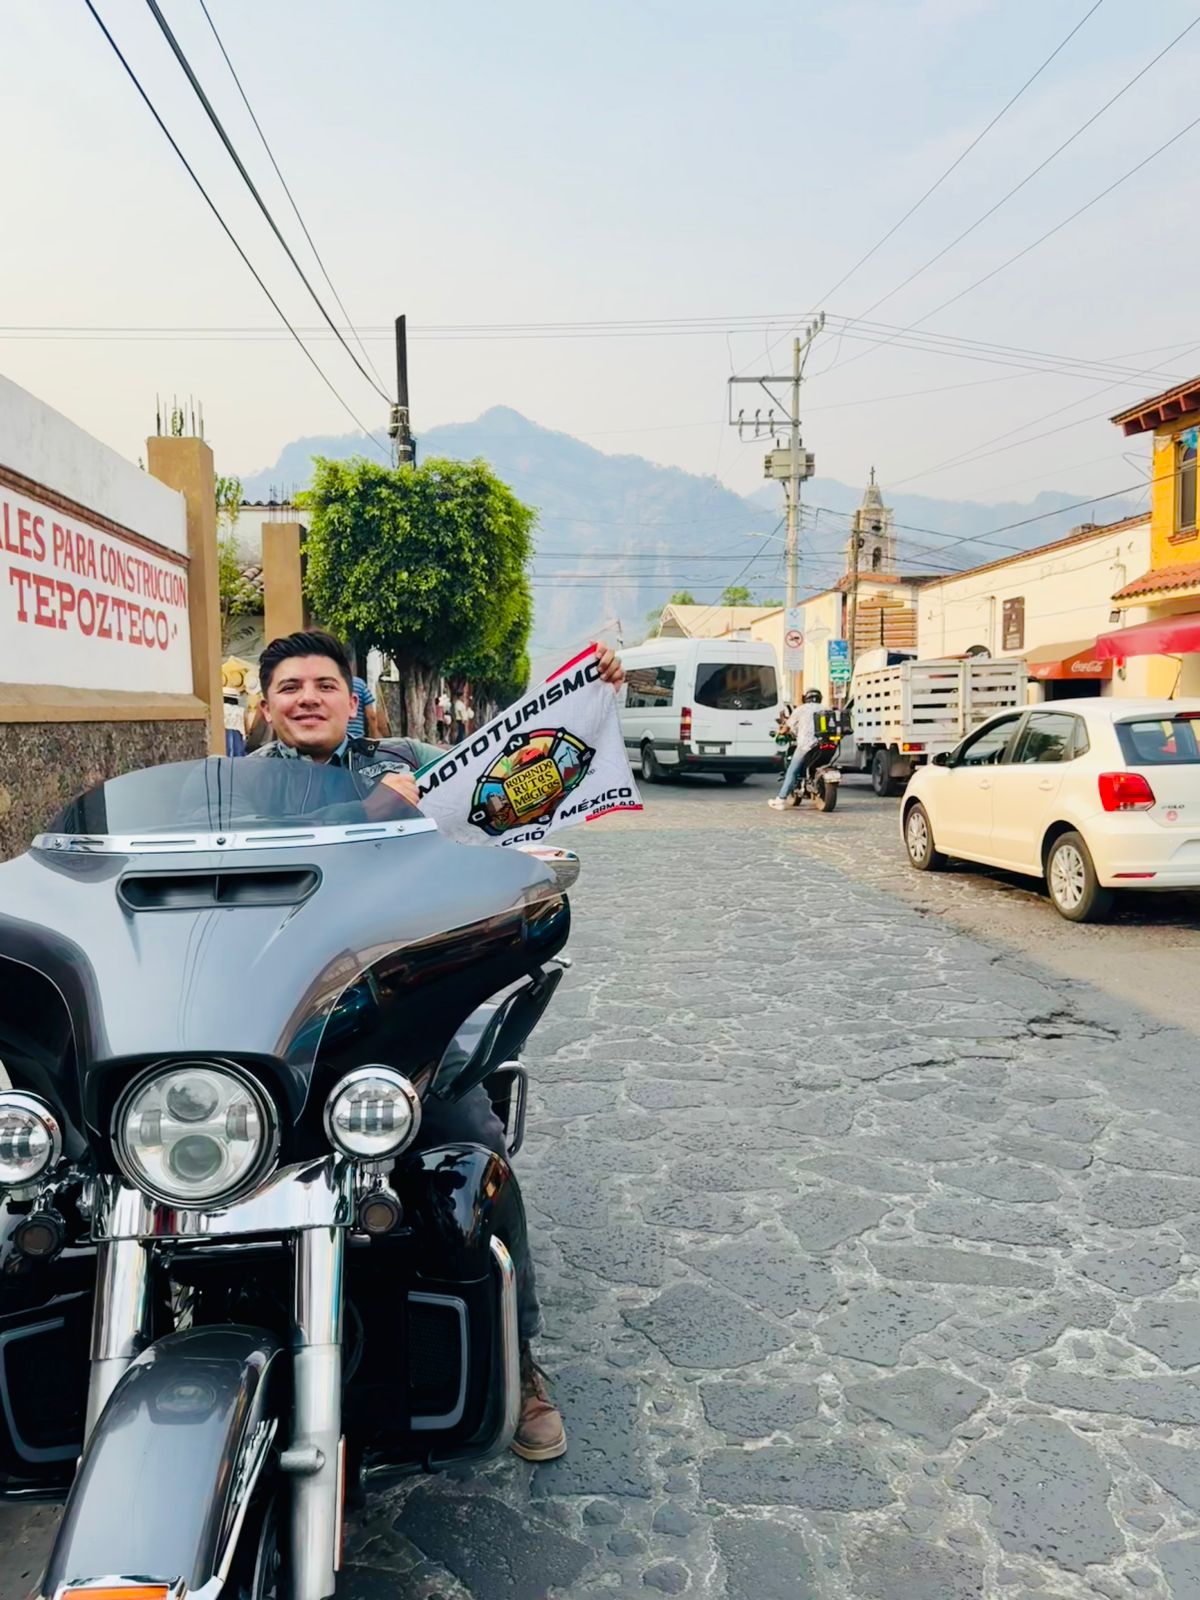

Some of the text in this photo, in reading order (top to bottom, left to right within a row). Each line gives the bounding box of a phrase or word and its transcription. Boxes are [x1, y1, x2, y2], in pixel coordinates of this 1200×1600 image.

[0, 502, 187, 609] LES PARA CONSTRUCCION
[418, 657, 602, 800] MOTOTURISMO
[560, 787, 632, 820] MÉXICO
